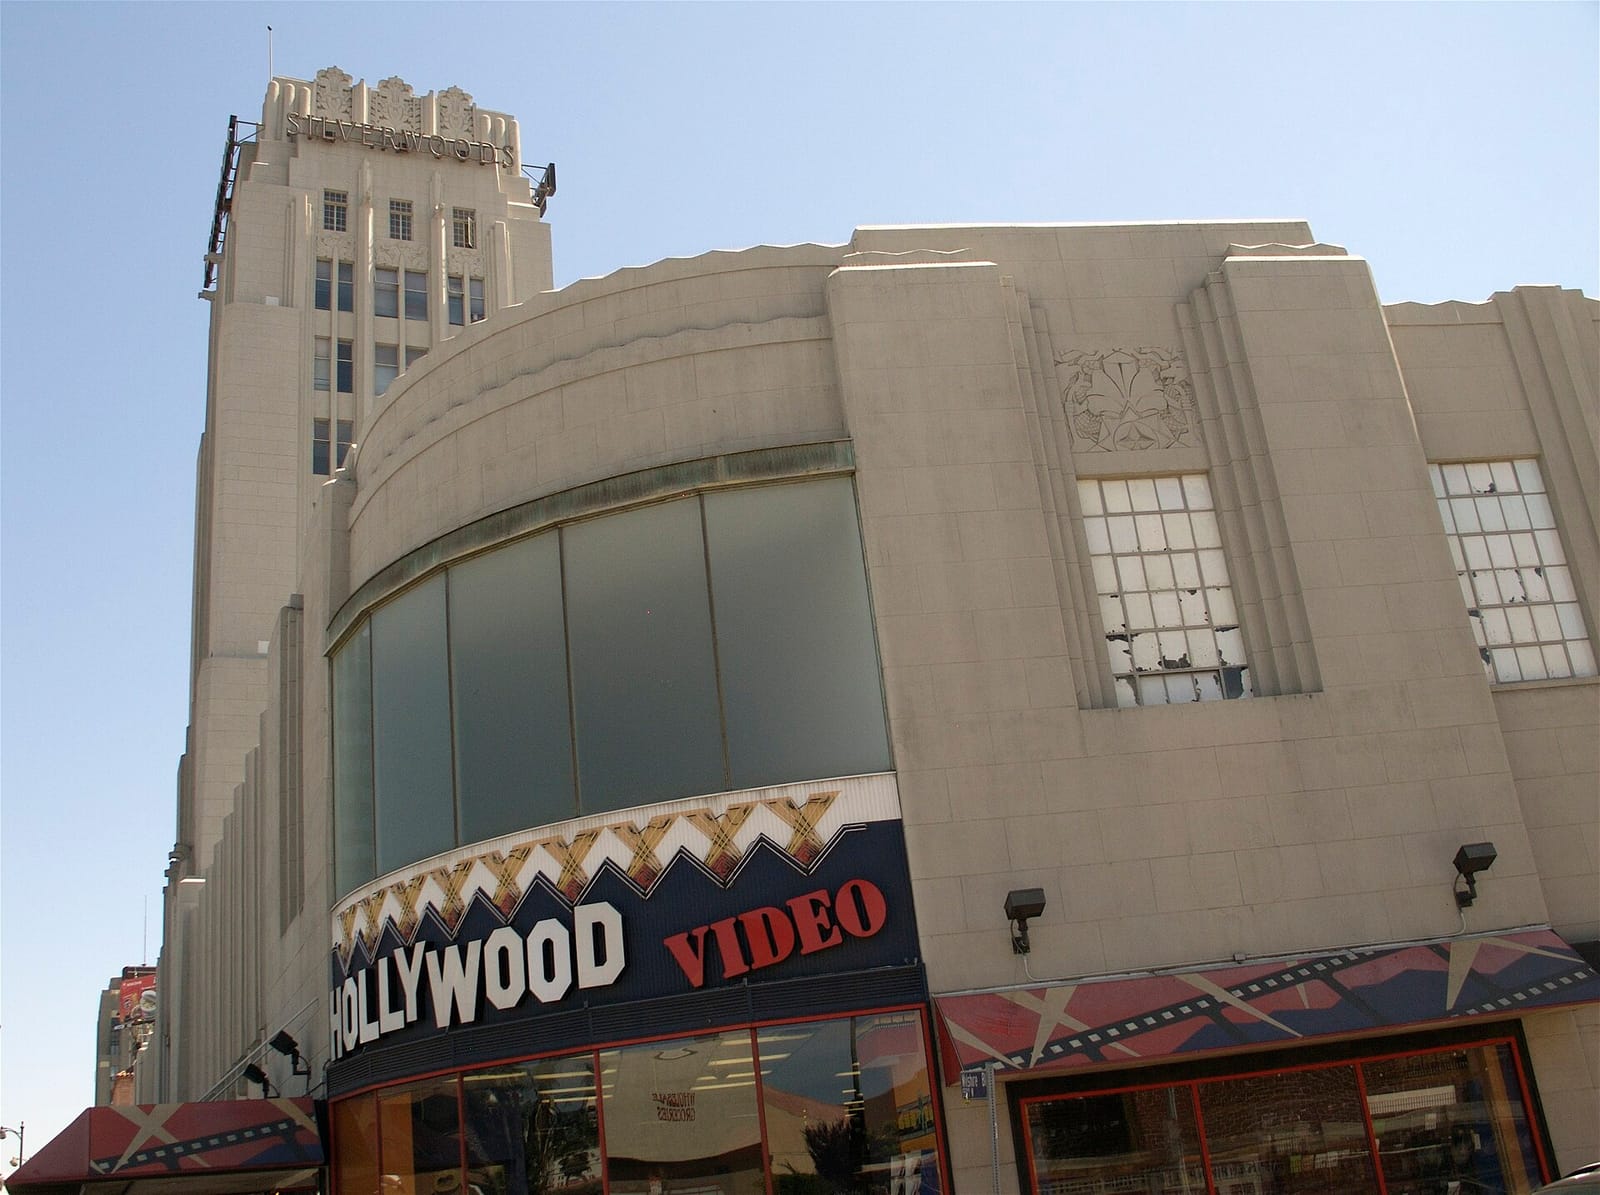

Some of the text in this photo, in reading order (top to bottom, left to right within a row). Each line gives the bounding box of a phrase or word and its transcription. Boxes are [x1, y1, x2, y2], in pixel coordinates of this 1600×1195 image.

[286, 111, 515, 168] SILVERWOODS
[329, 878, 888, 1061] HOLLYWOOD VIDEO
